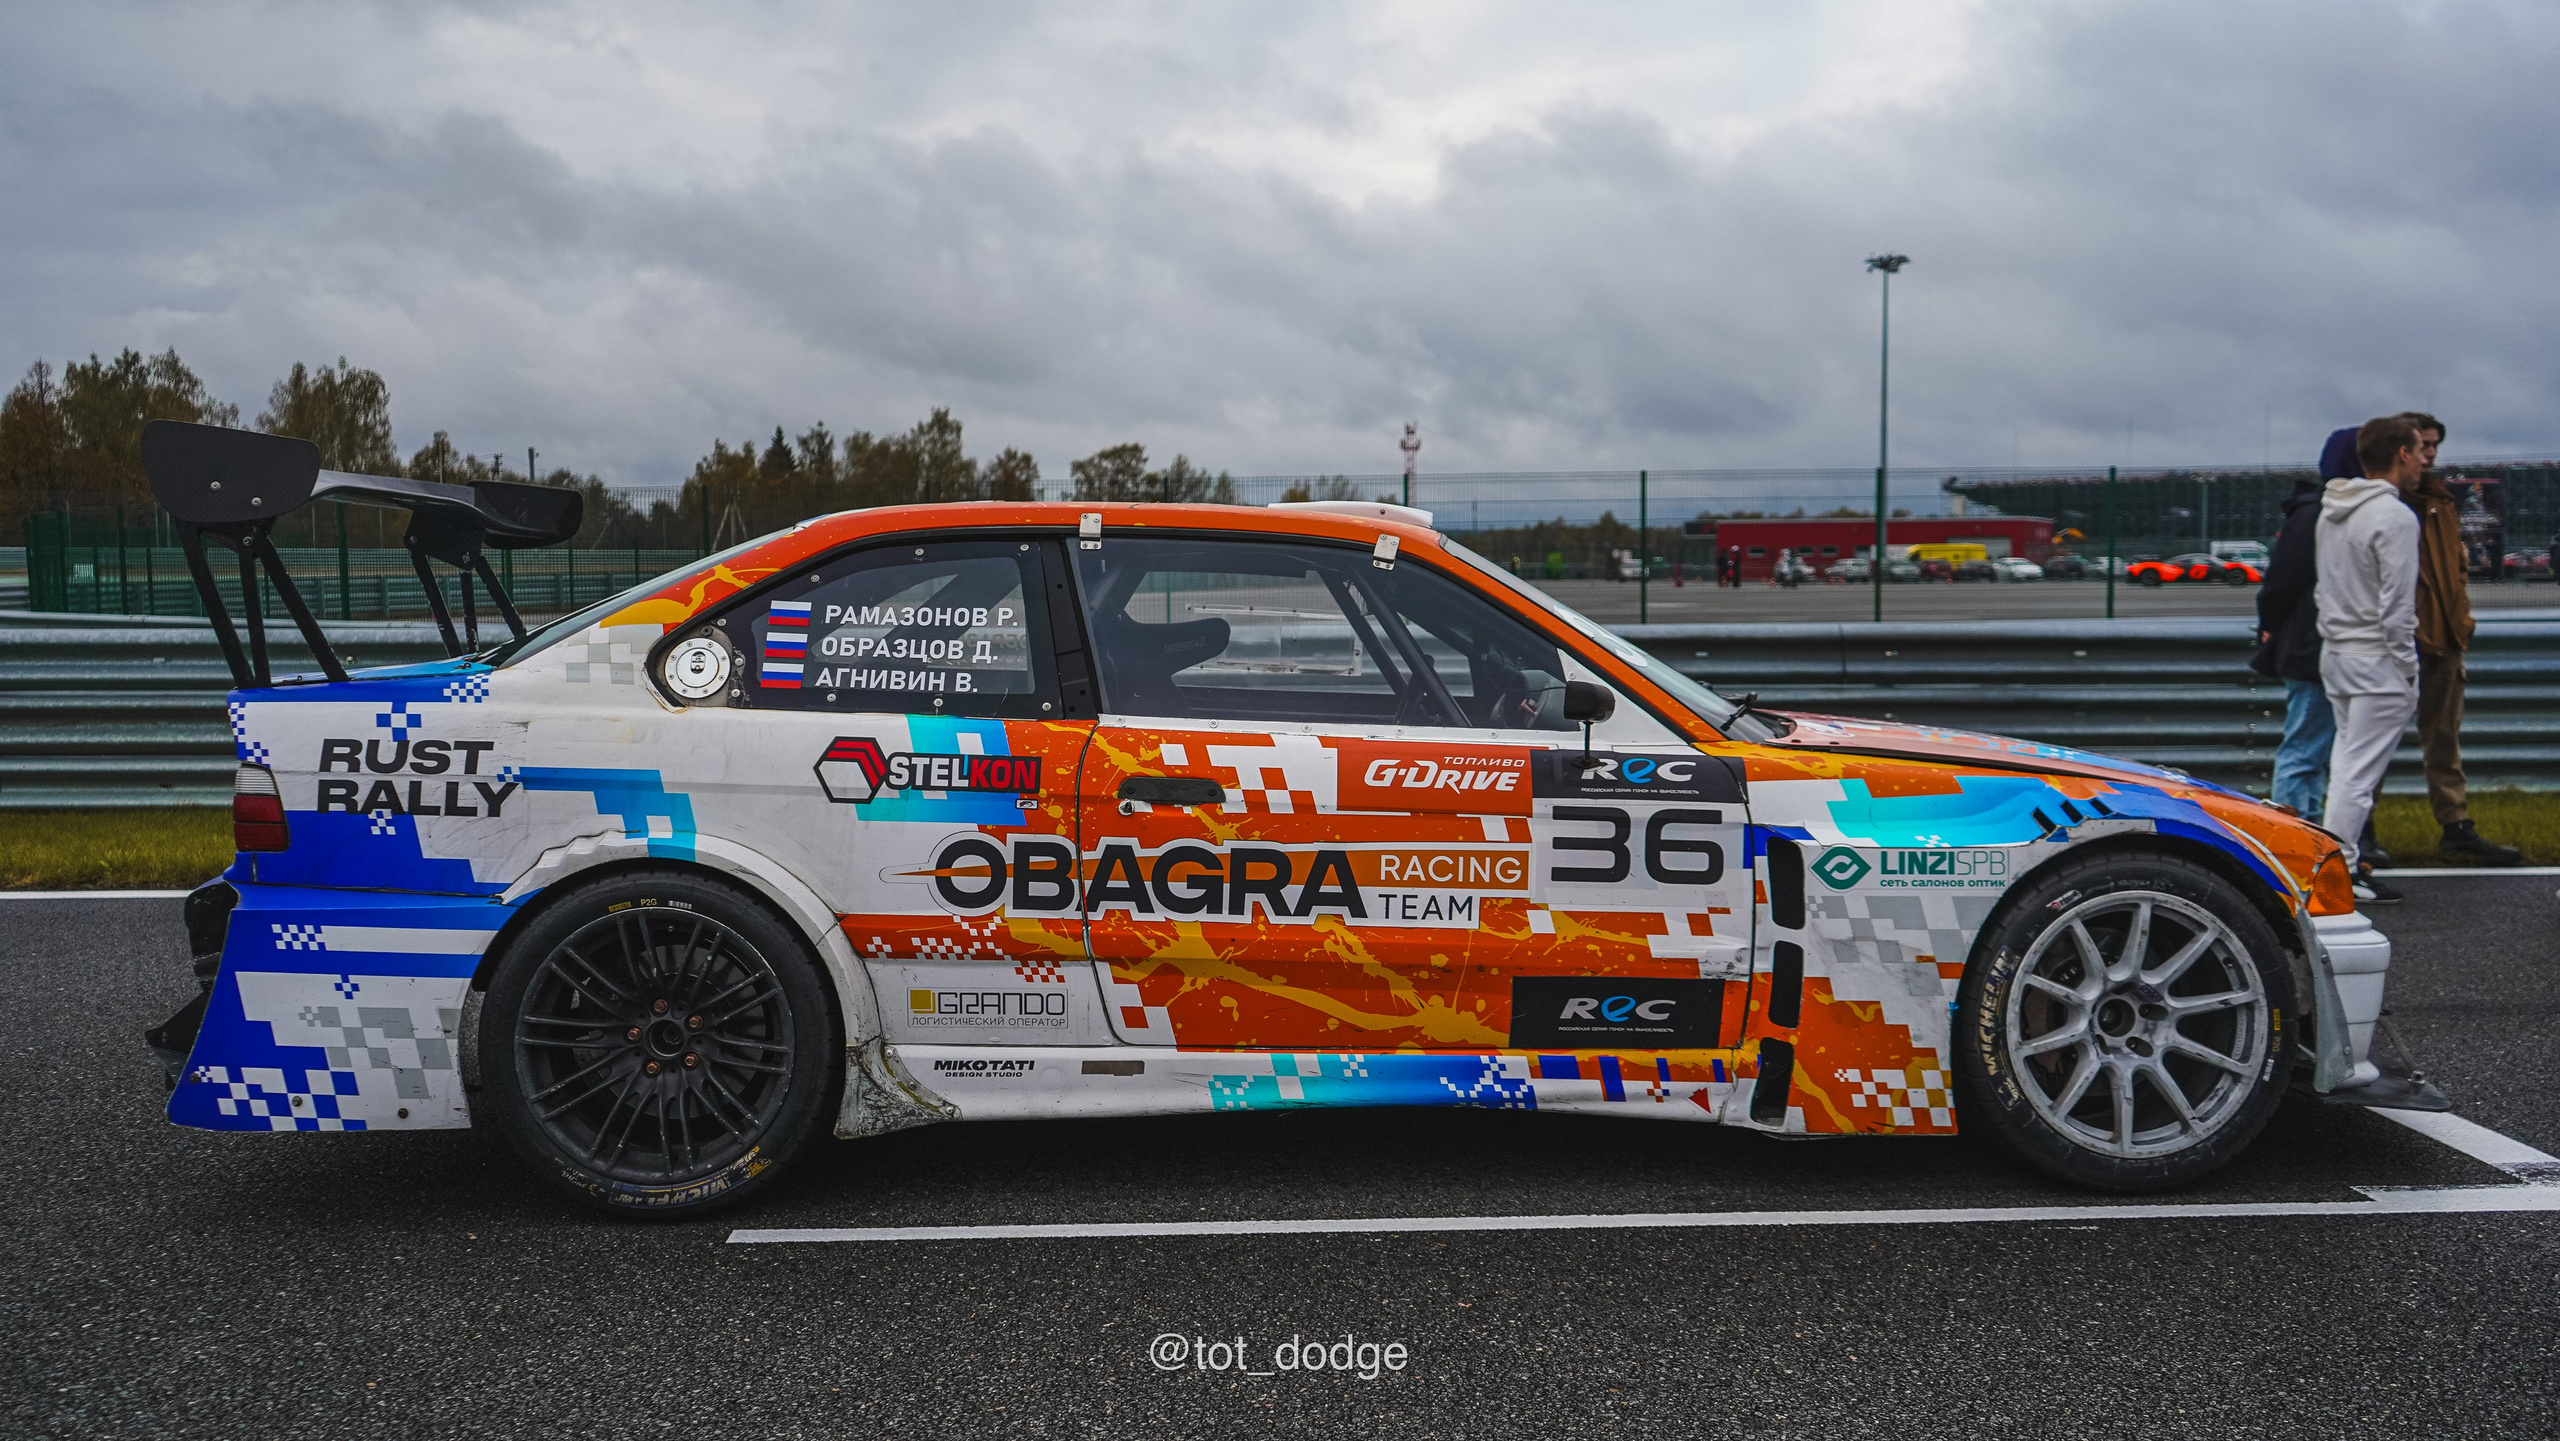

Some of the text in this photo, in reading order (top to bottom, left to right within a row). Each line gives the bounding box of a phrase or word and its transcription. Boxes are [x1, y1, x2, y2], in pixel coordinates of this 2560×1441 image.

[825, 605, 1018, 627] РАМАЗОНОВ Р.
[821, 637, 998, 664] ОБРАЗЦОВ Д.
[815, 667, 978, 692] АГНИВИН В.
[319, 739, 494, 775] RUST
[889, 757, 1036, 789] STELKON
[317, 780, 519, 817] RALLY
[1551, 805, 1724, 886] 36
[935, 838, 1369, 919] OBAGRA
[1380, 854, 1523, 884] RACING
[1880, 878, 2006, 887] сеть салонов оптик
[1378, 893, 1474, 922] TEAM
[938, 992, 1066, 1015] GRANDO
[911, 1016, 1066, 1027] ЛОГИСТИЧЕСКИЙ ОПЕРАТОР
[933, 1060, 1035, 1071] MIKOTATI
